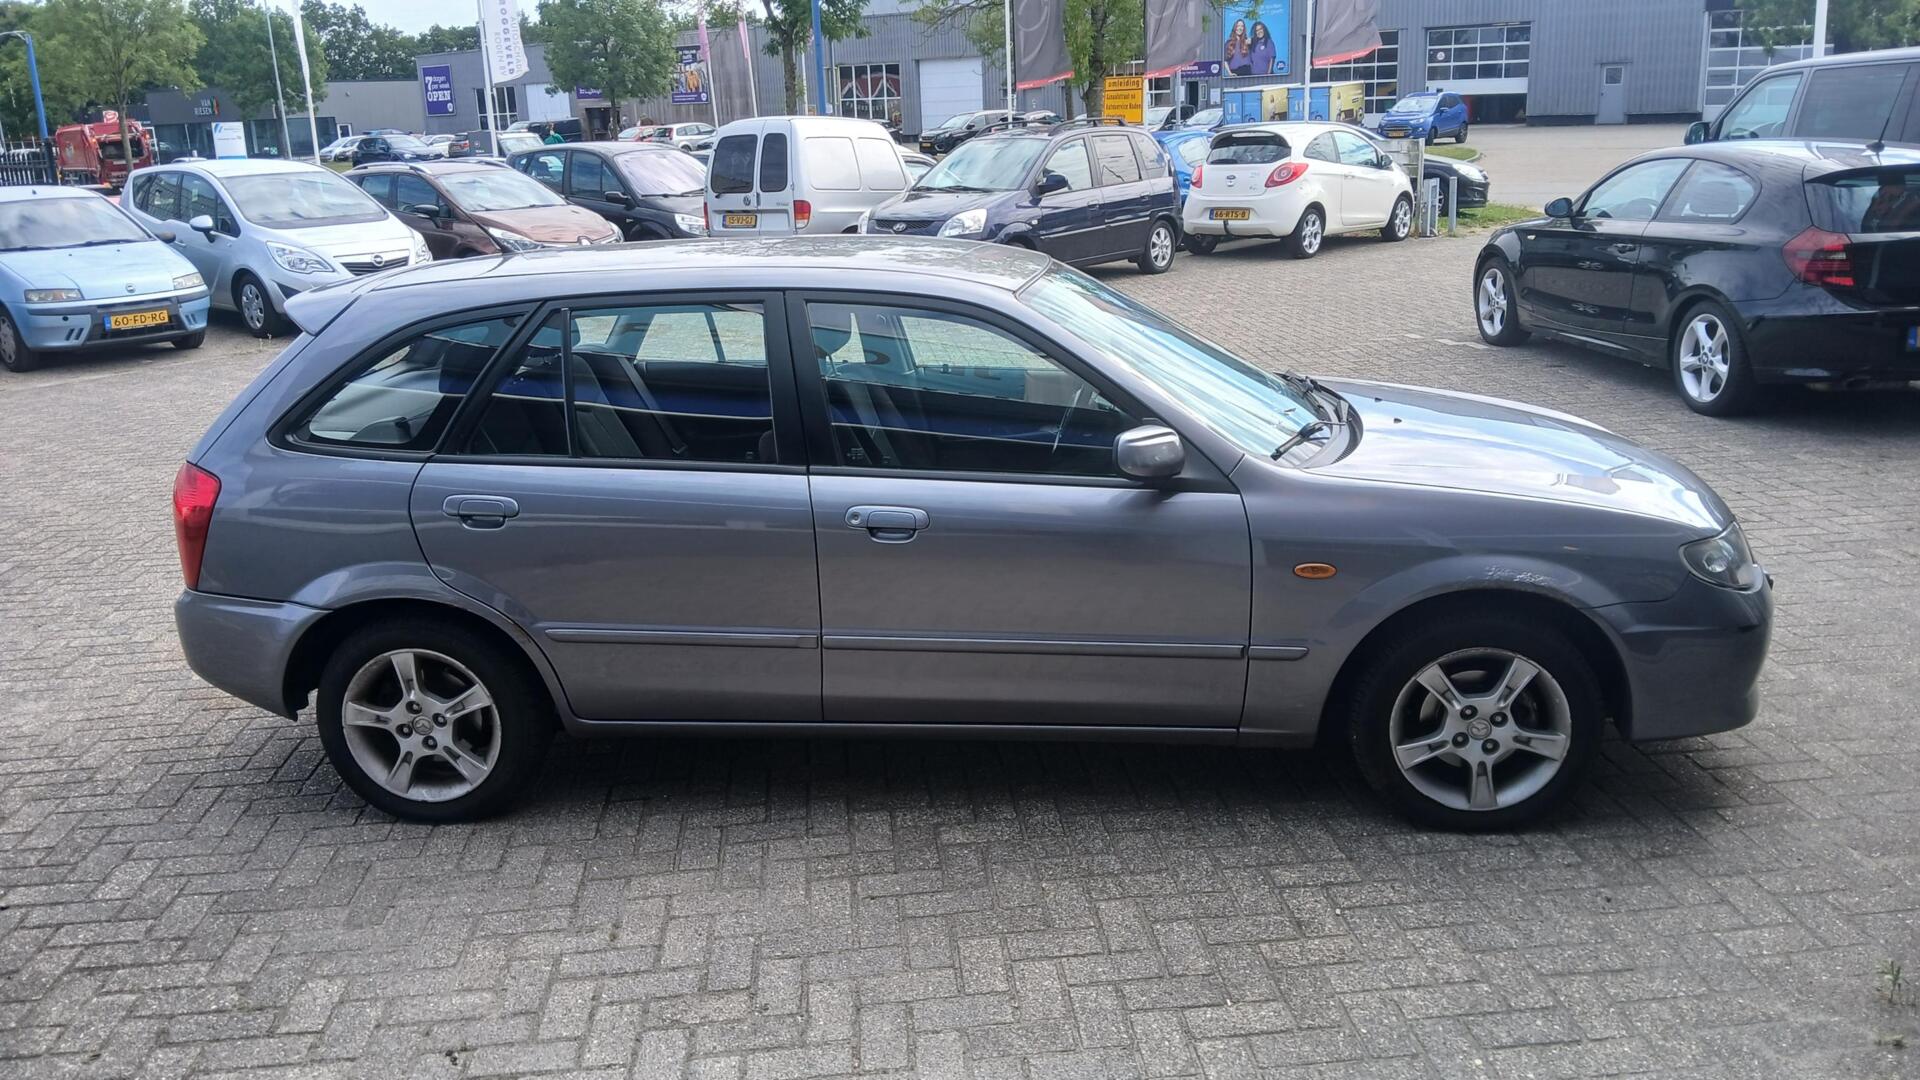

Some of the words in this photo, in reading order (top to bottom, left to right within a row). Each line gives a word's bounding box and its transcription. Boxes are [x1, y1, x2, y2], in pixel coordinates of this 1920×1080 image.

[425, 76, 432, 91] 7
[1108, 80, 1140, 88] omleiding
[427, 90, 450, 102] OPEN
[114, 312, 166, 327] 60-FD-RG
